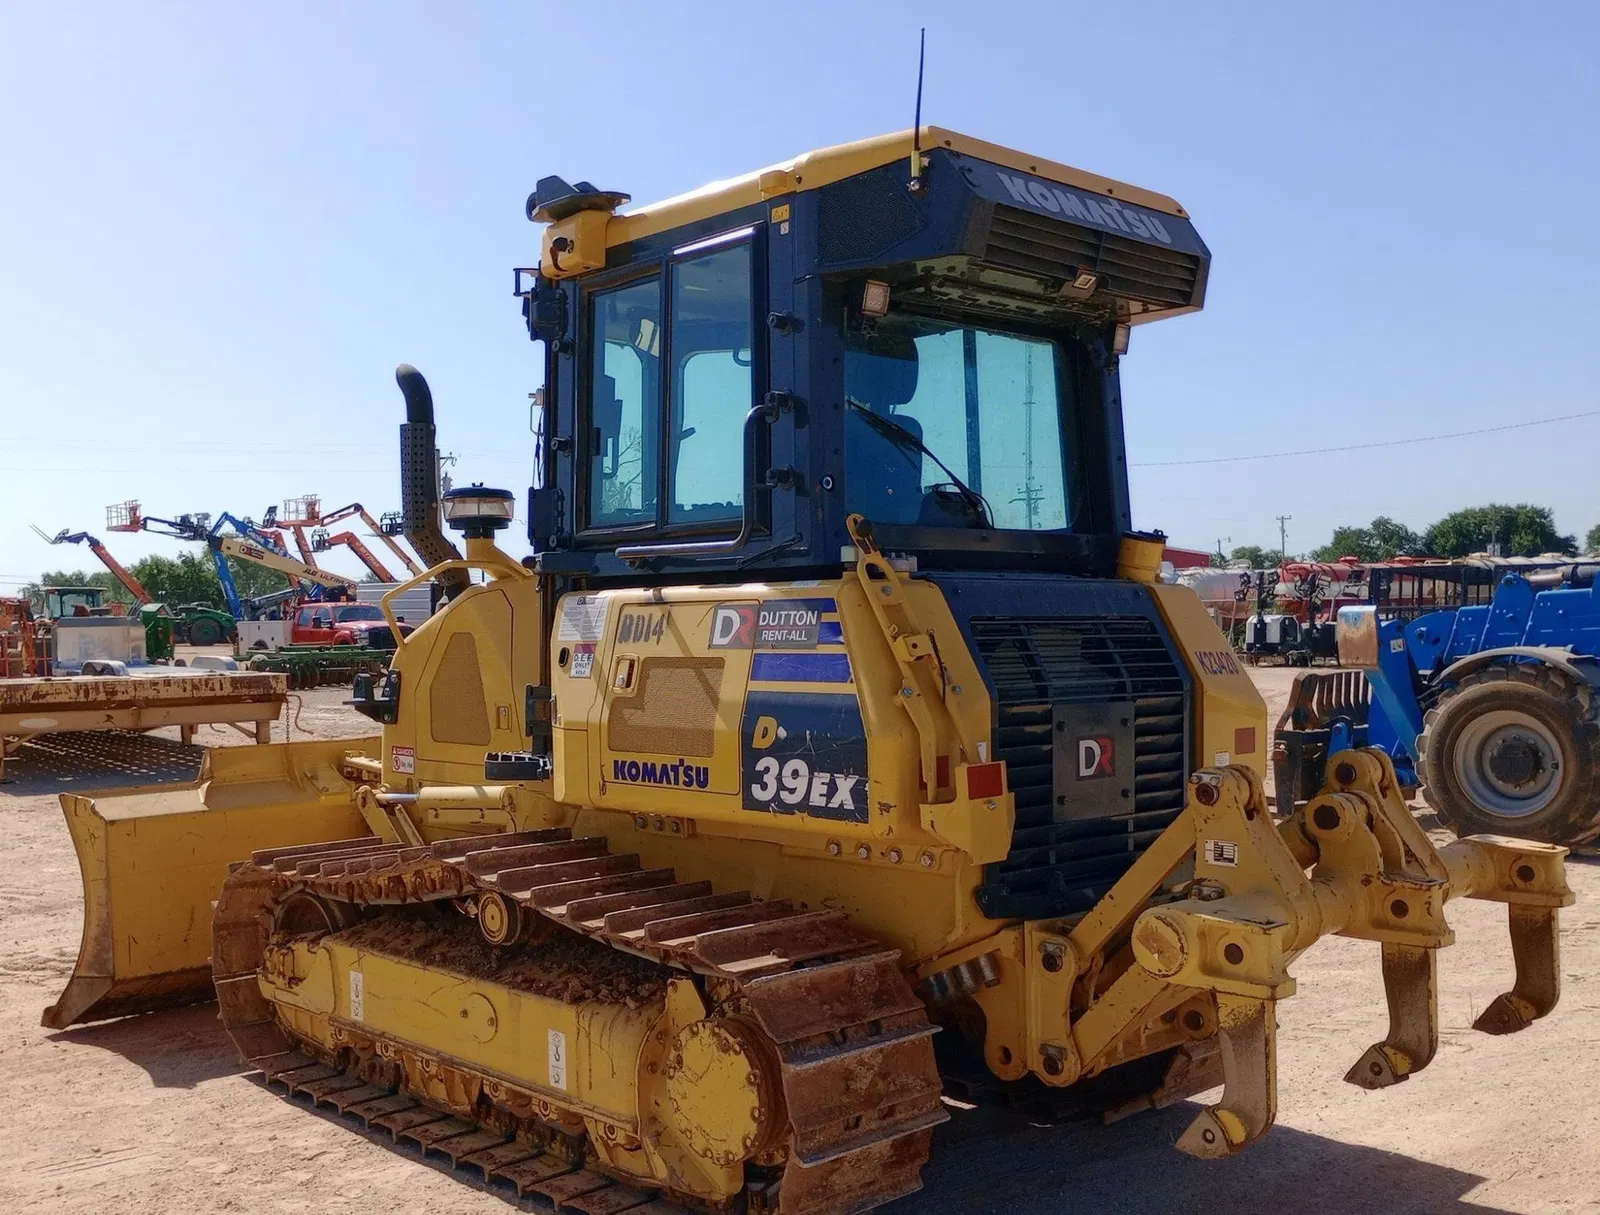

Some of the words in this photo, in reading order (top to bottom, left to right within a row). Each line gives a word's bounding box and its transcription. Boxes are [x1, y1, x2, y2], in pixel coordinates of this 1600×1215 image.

[997, 172, 1172, 244] KOMATSU
[713, 607, 753, 645] DR
[759, 610, 818, 626] DUTTON
[761, 630, 808, 641] RENT-ALL
[752, 715, 777, 749] D
[613, 758, 709, 788] KOMATSU
[1079, 737, 1113, 777] DR
[751, 756, 859, 810] 39EX
